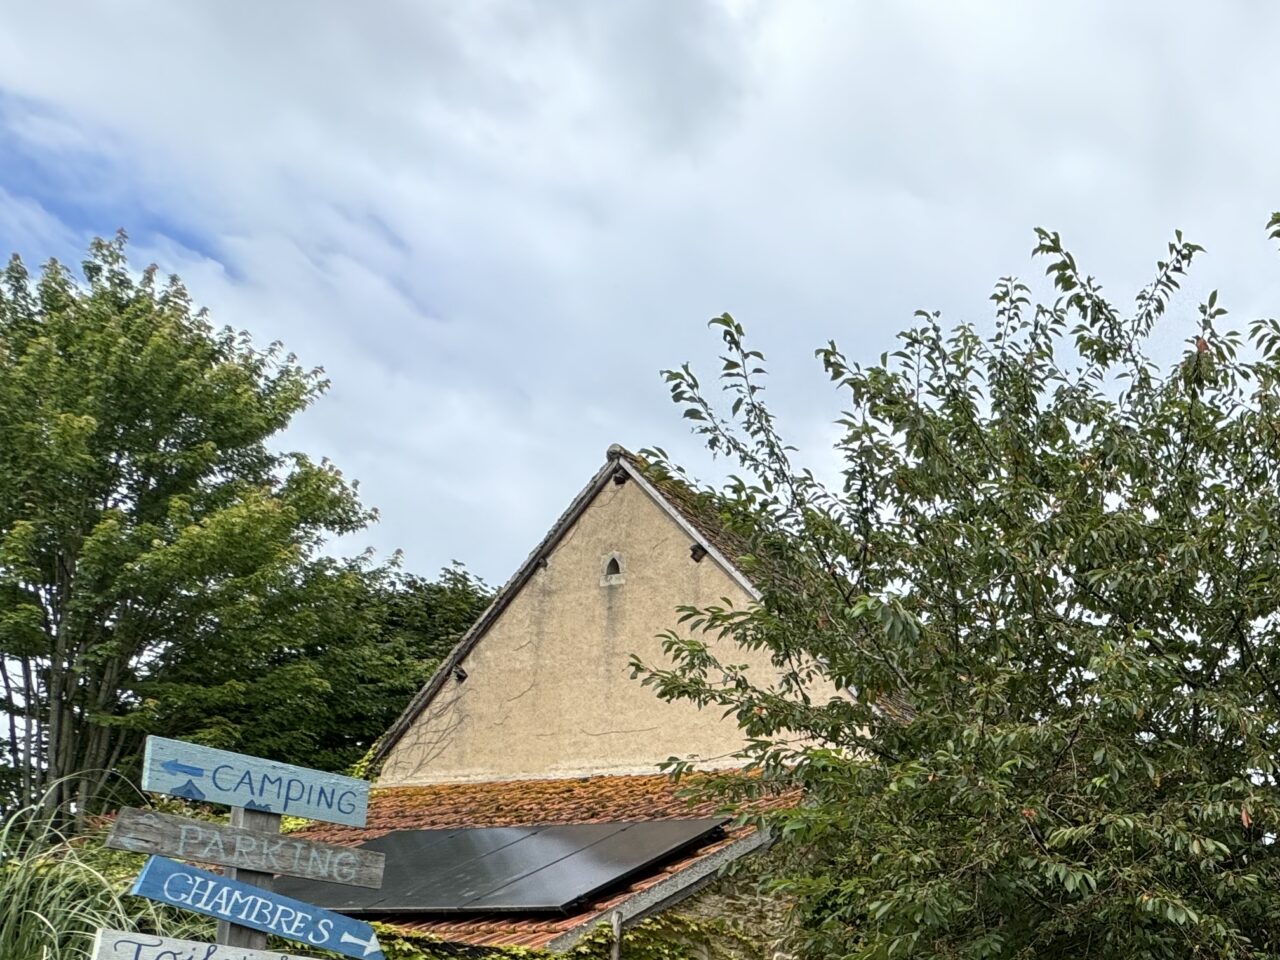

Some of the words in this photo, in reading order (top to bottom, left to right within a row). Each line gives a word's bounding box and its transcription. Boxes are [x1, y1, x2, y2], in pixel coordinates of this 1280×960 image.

[211, 764, 357, 815] CAMPING
[175, 824, 360, 883] PARKING
[163, 871, 333, 945] CHAMBRES
